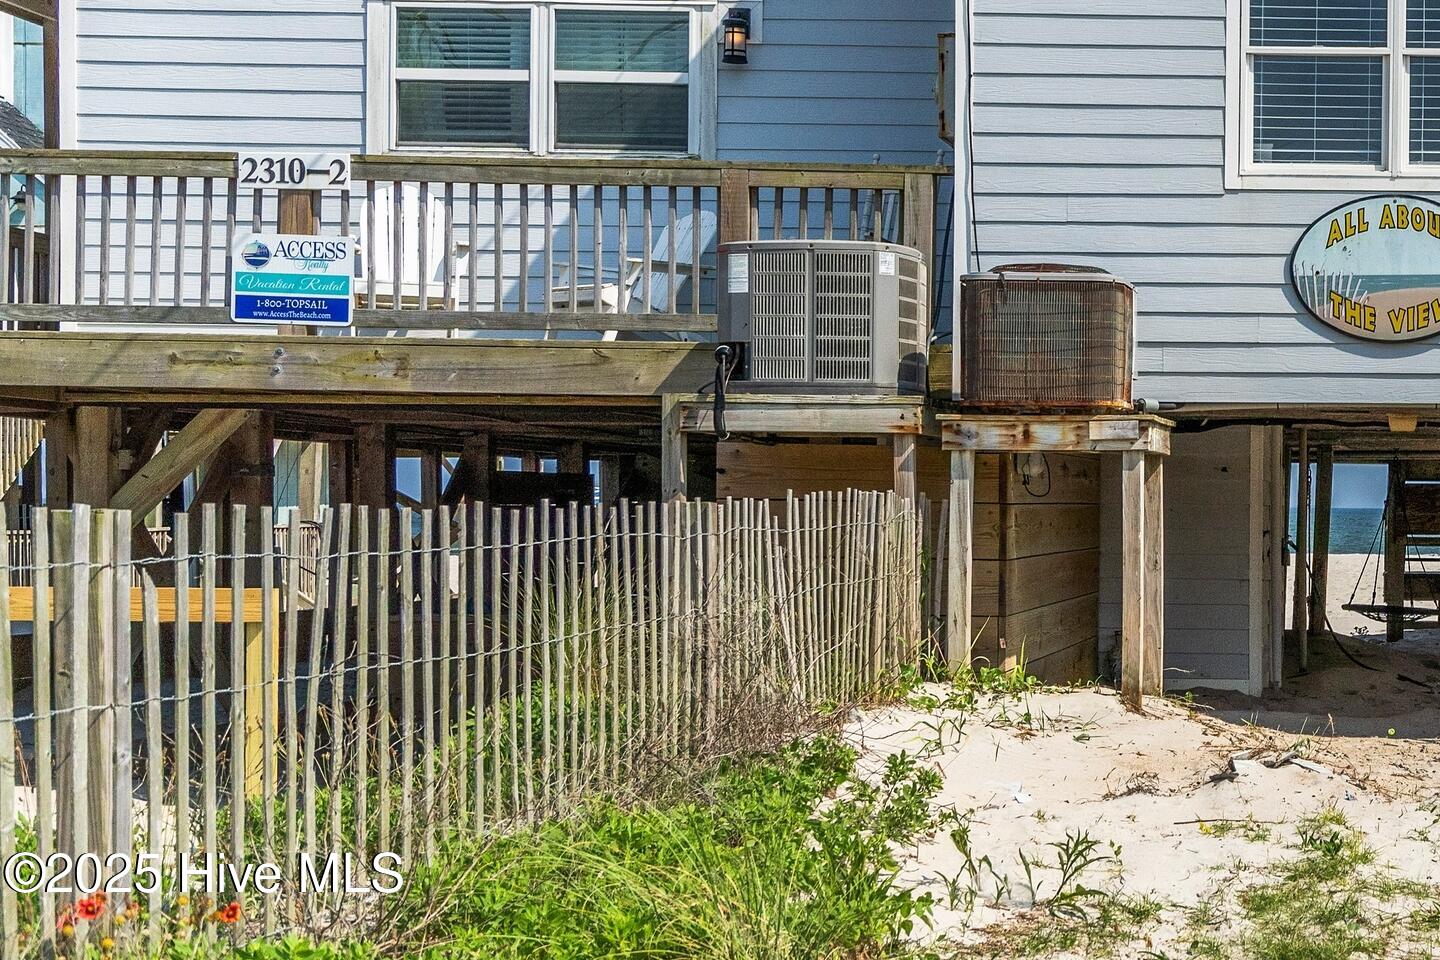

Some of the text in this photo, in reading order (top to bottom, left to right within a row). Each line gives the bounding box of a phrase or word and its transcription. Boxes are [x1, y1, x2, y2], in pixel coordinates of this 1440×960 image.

[240, 157, 347, 186] 2310-2
[1325, 207, 1370, 250] ALL
[273, 240, 347, 260] ACCESS
[293, 259, 329, 273] Realty
[238, 274, 346, 292] Vacation Rental
[256, 298, 328, 310] 1-800-TOPSAIL
[1329, 290, 1377, 333] THE
[252, 310, 332, 319] www.AccessTheBeach.com
